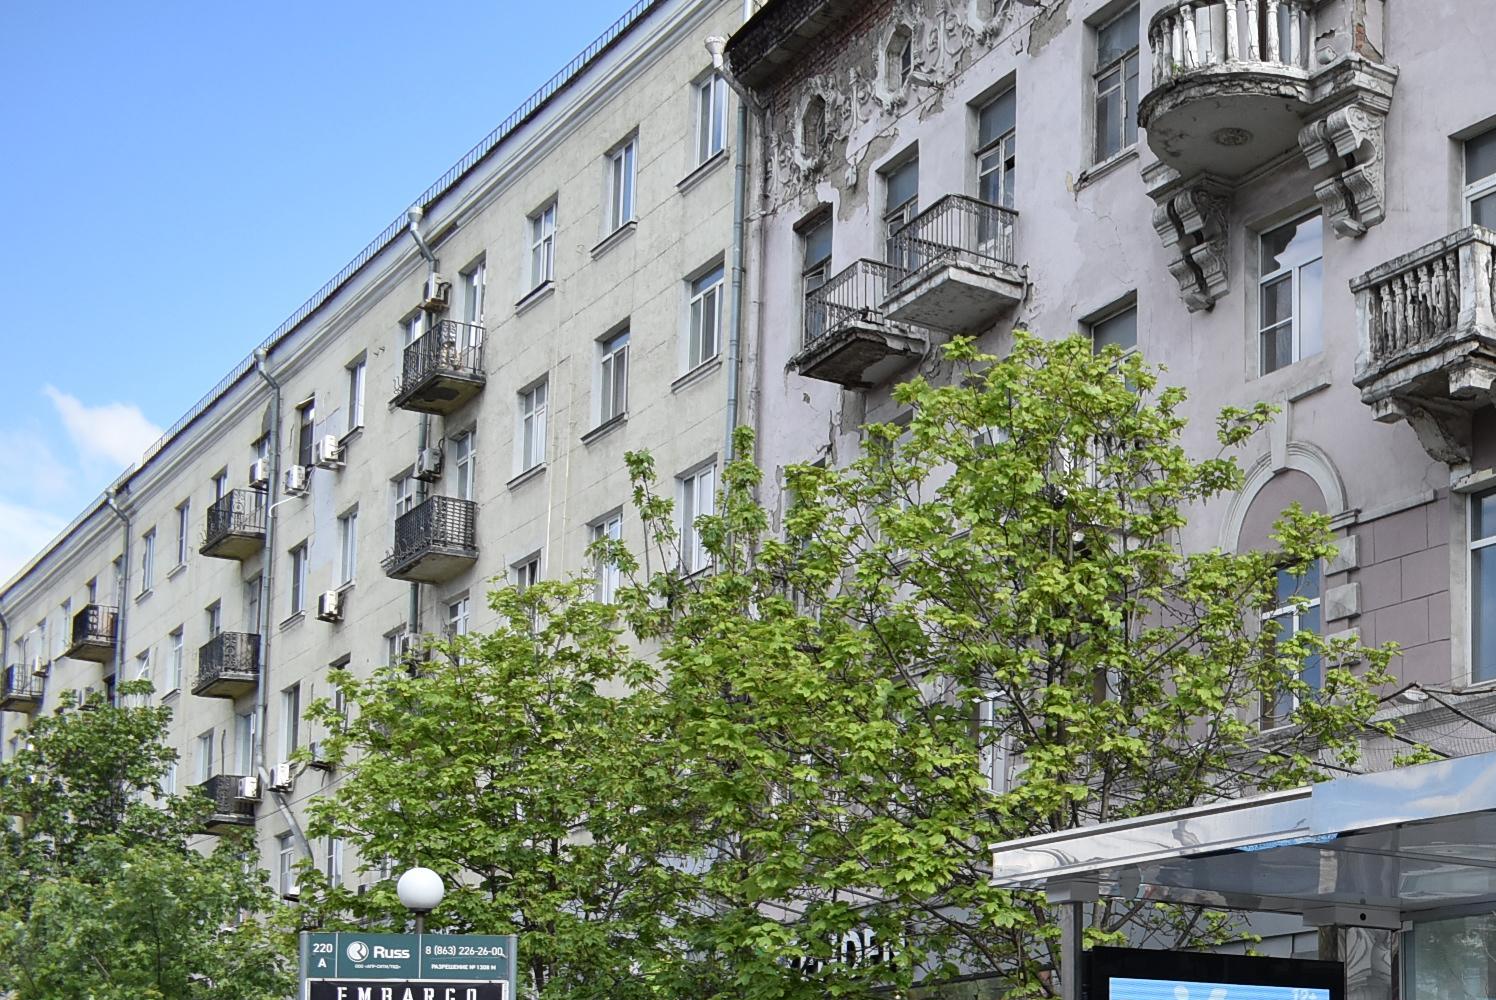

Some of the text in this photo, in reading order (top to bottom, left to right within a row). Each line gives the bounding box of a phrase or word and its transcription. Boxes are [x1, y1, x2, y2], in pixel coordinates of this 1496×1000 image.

[312, 943, 333, 953] 220
[373, 945, 410, 959] Russ
[425, 945, 503, 956] 8 (863) 226-26-00
